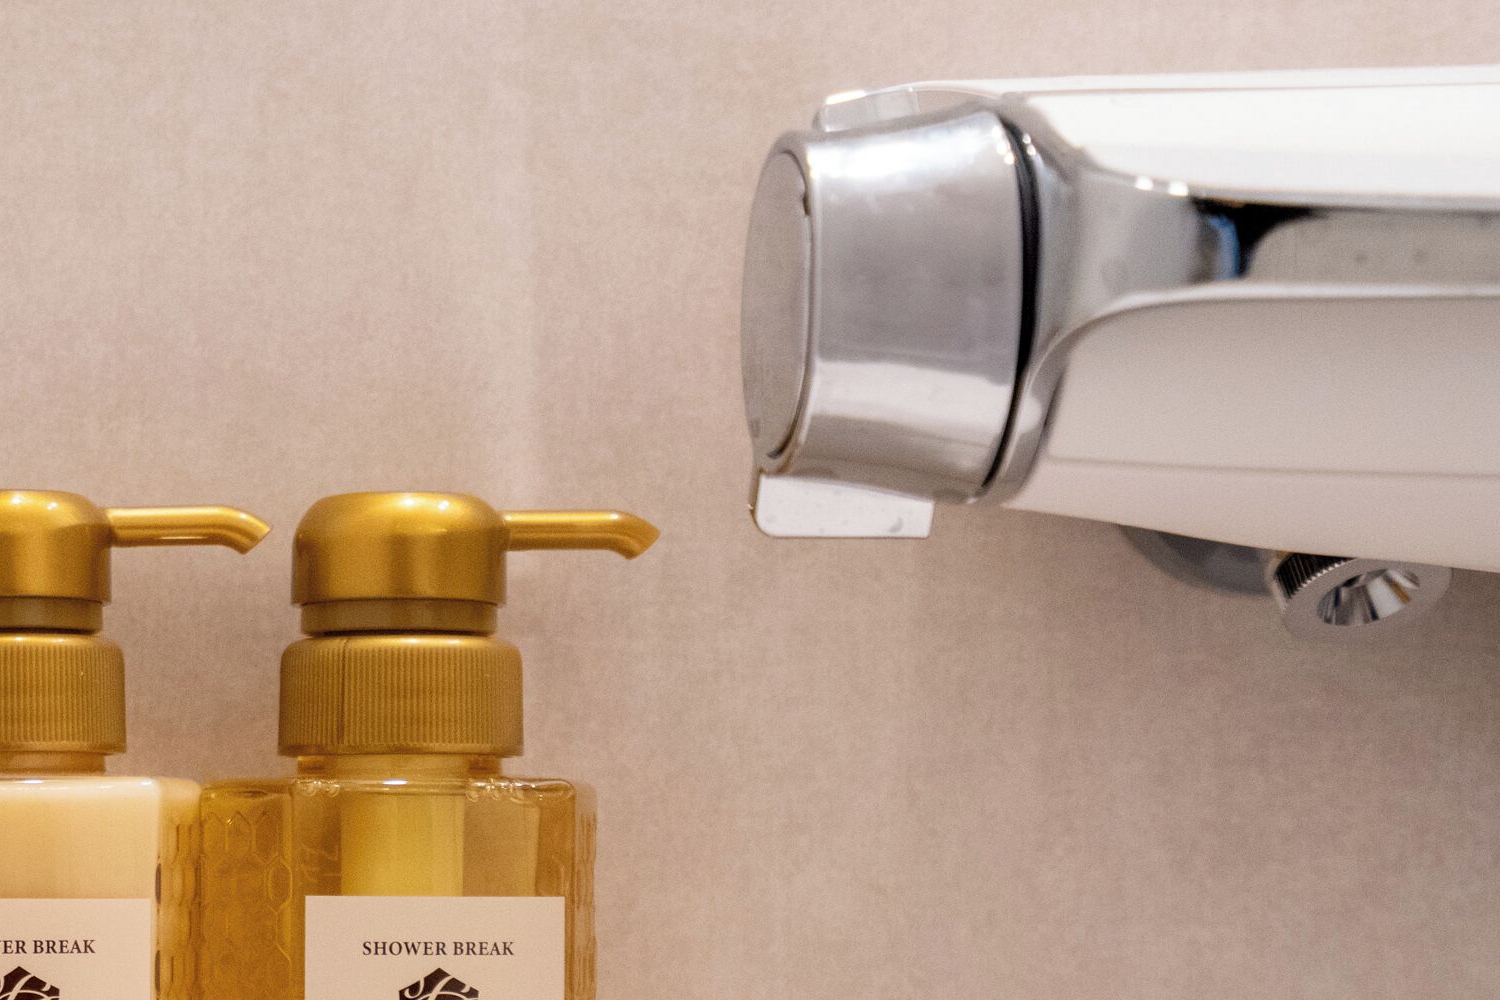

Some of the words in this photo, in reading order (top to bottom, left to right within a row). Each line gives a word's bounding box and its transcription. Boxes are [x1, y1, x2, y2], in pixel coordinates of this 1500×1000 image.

[32, 939, 96, 954] BREAK
[362, 941, 447, 956] SHOWER
[452, 941, 514, 956] BREAK
